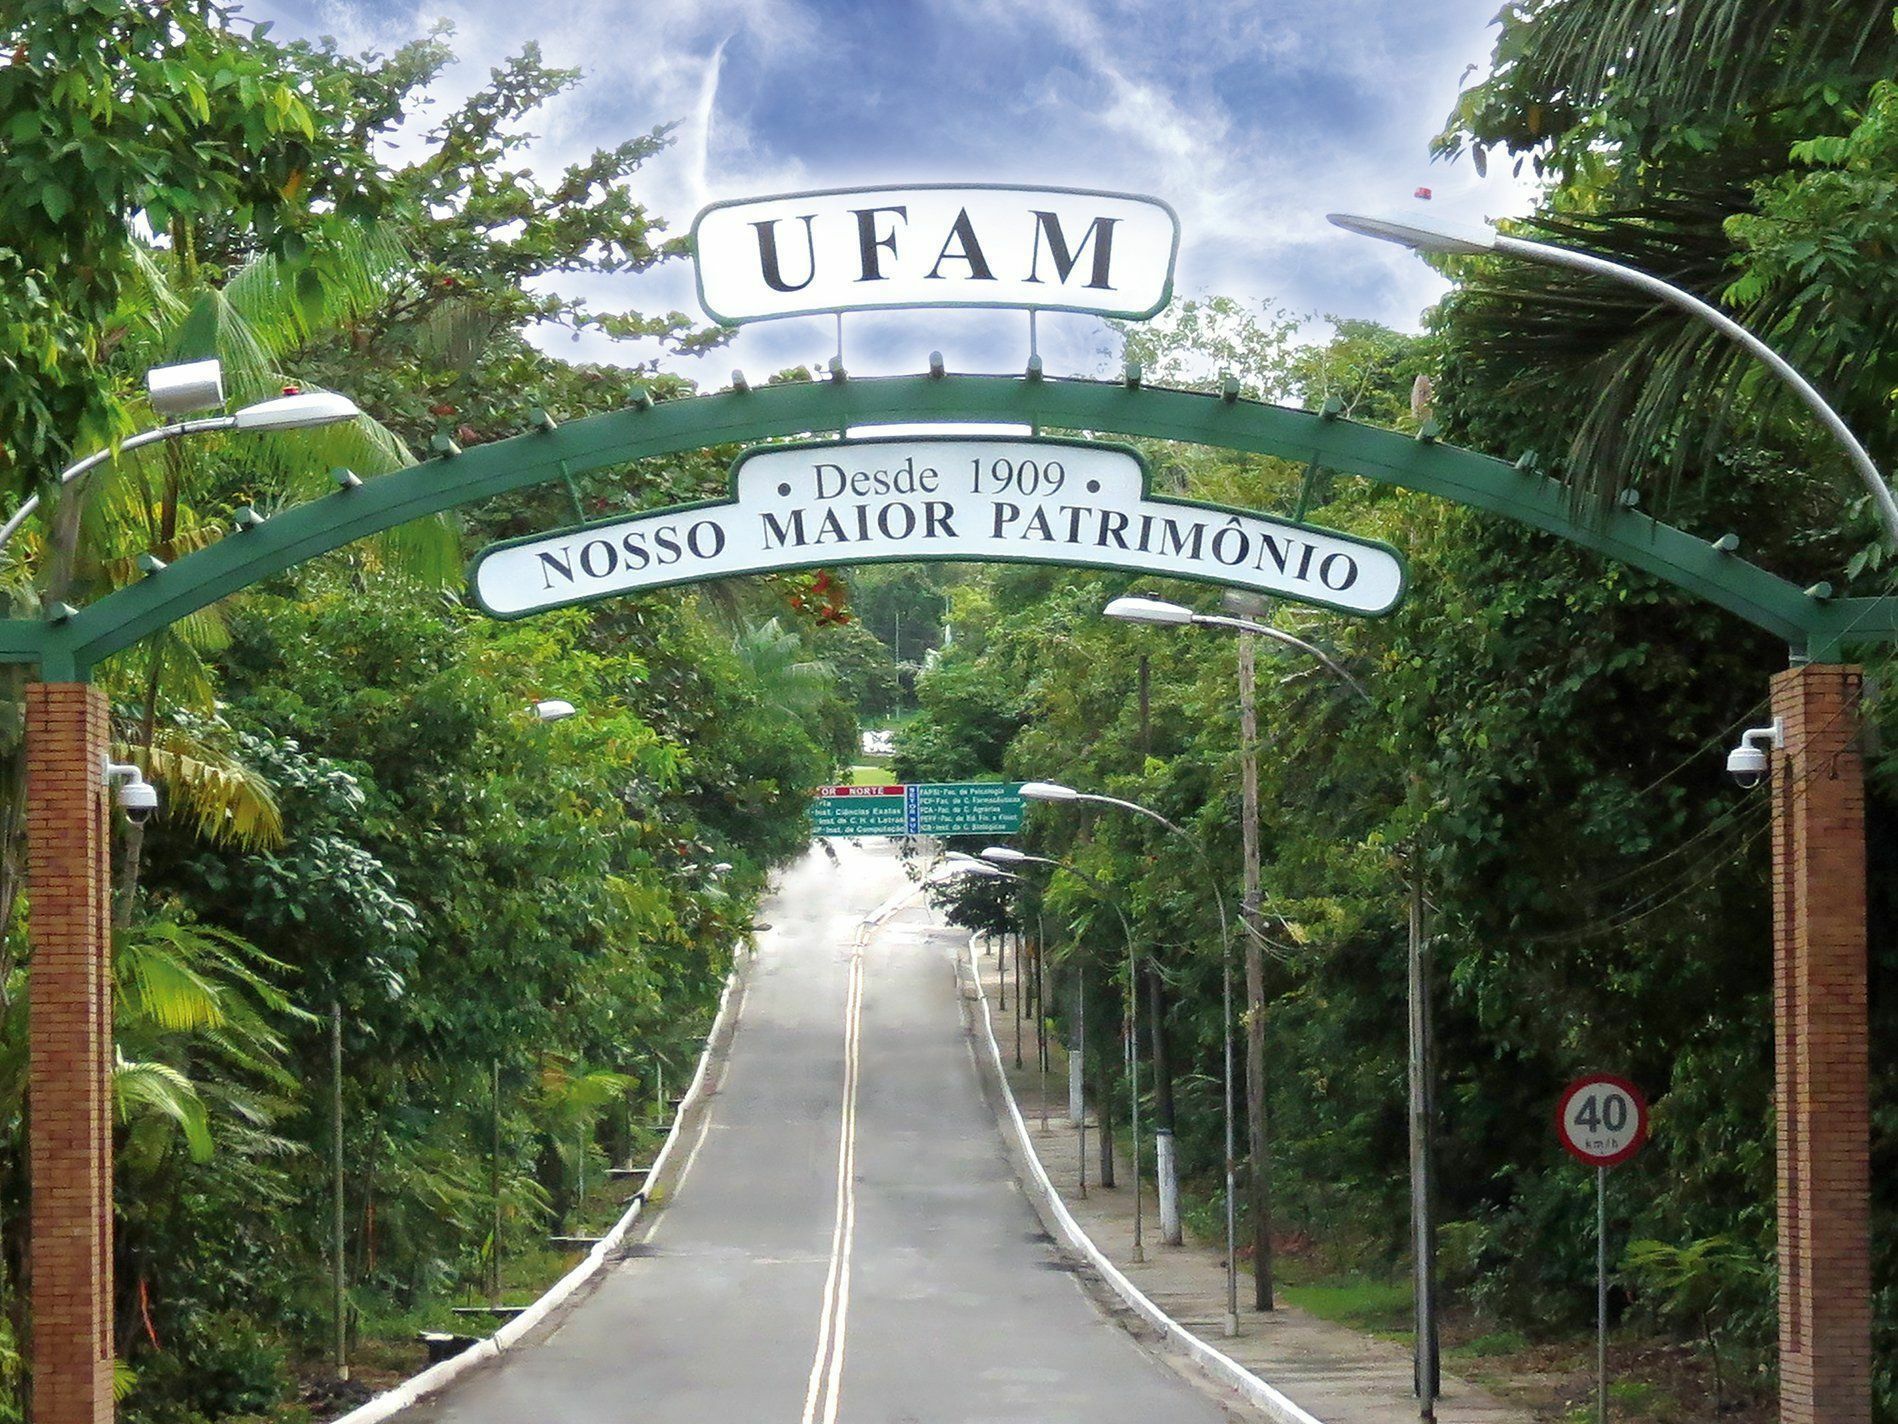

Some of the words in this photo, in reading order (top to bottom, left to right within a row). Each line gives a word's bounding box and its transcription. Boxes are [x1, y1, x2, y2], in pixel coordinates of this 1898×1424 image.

[750, 205, 1119, 293] UFAM
[813, 456, 940, 500] Desde
[971, 458, 1066, 497] 1909
[537, 520, 726, 593] NOSSO
[760, 502, 960, 547] MAIOR
[991, 502, 1360, 592] PATRIMÔNIO
[849, 787, 884, 796] NORTE
[1574, 1093, 1627, 1133] 40
[1585, 1138, 1619, 1149] km/h
